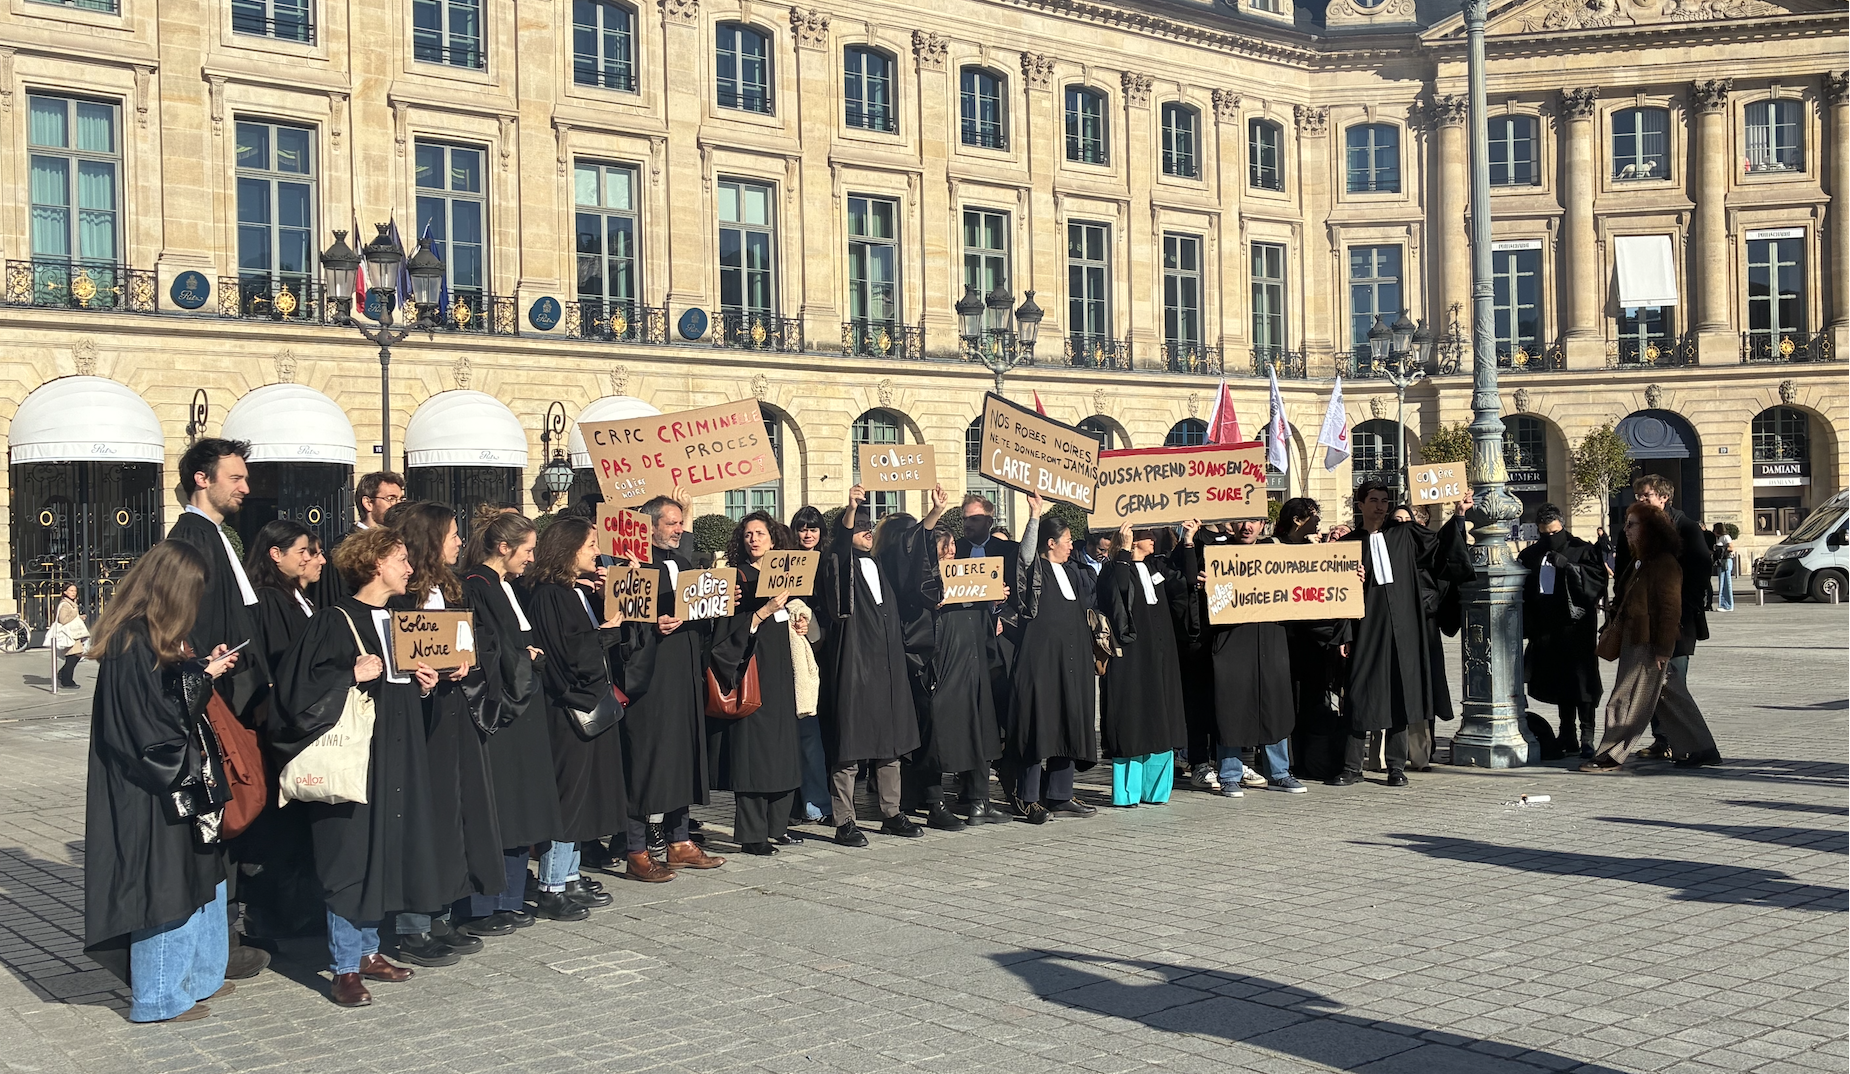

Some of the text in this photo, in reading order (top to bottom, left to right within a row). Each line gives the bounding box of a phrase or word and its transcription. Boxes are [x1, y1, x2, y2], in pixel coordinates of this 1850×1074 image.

[594, 428, 644, 447] CRPC
[990, 409, 1010, 430] NOS
[1015, 422, 1047, 445] ROBES
[601, 433, 758, 479] PAS DE PROCES
[990, 432, 1000, 444] NE
[1001, 438, 1010, 449] TE
[1014, 442, 1062, 466] DONNERONT
[880, 470, 919, 482] NOIRE
[992, 448, 1031, 485] CARTE
[1096, 467, 1142, 488] OUSSA
[1144, 462, 1186, 483] PREND
[1188, 460, 1205, 477] 30
[1226, 460, 1241, 475] EN
[1507, 472, 1540, 481] UMER
[1762, 465, 1801, 474] DAMIANI
[621, 488, 646, 499] NOIRE
[1419, 482, 1460, 500] NOIRE
[1115, 493, 1170, 517] GERALD
[612, 536, 649, 562] NOIRE
[1265, 560, 1318, 575] COUPABLE
[619, 596, 652, 618] NOIRE
[1273, 589, 1289, 603] EN
[688, 595, 730, 621] NOIRE
[410, 637, 451, 659] Noire
